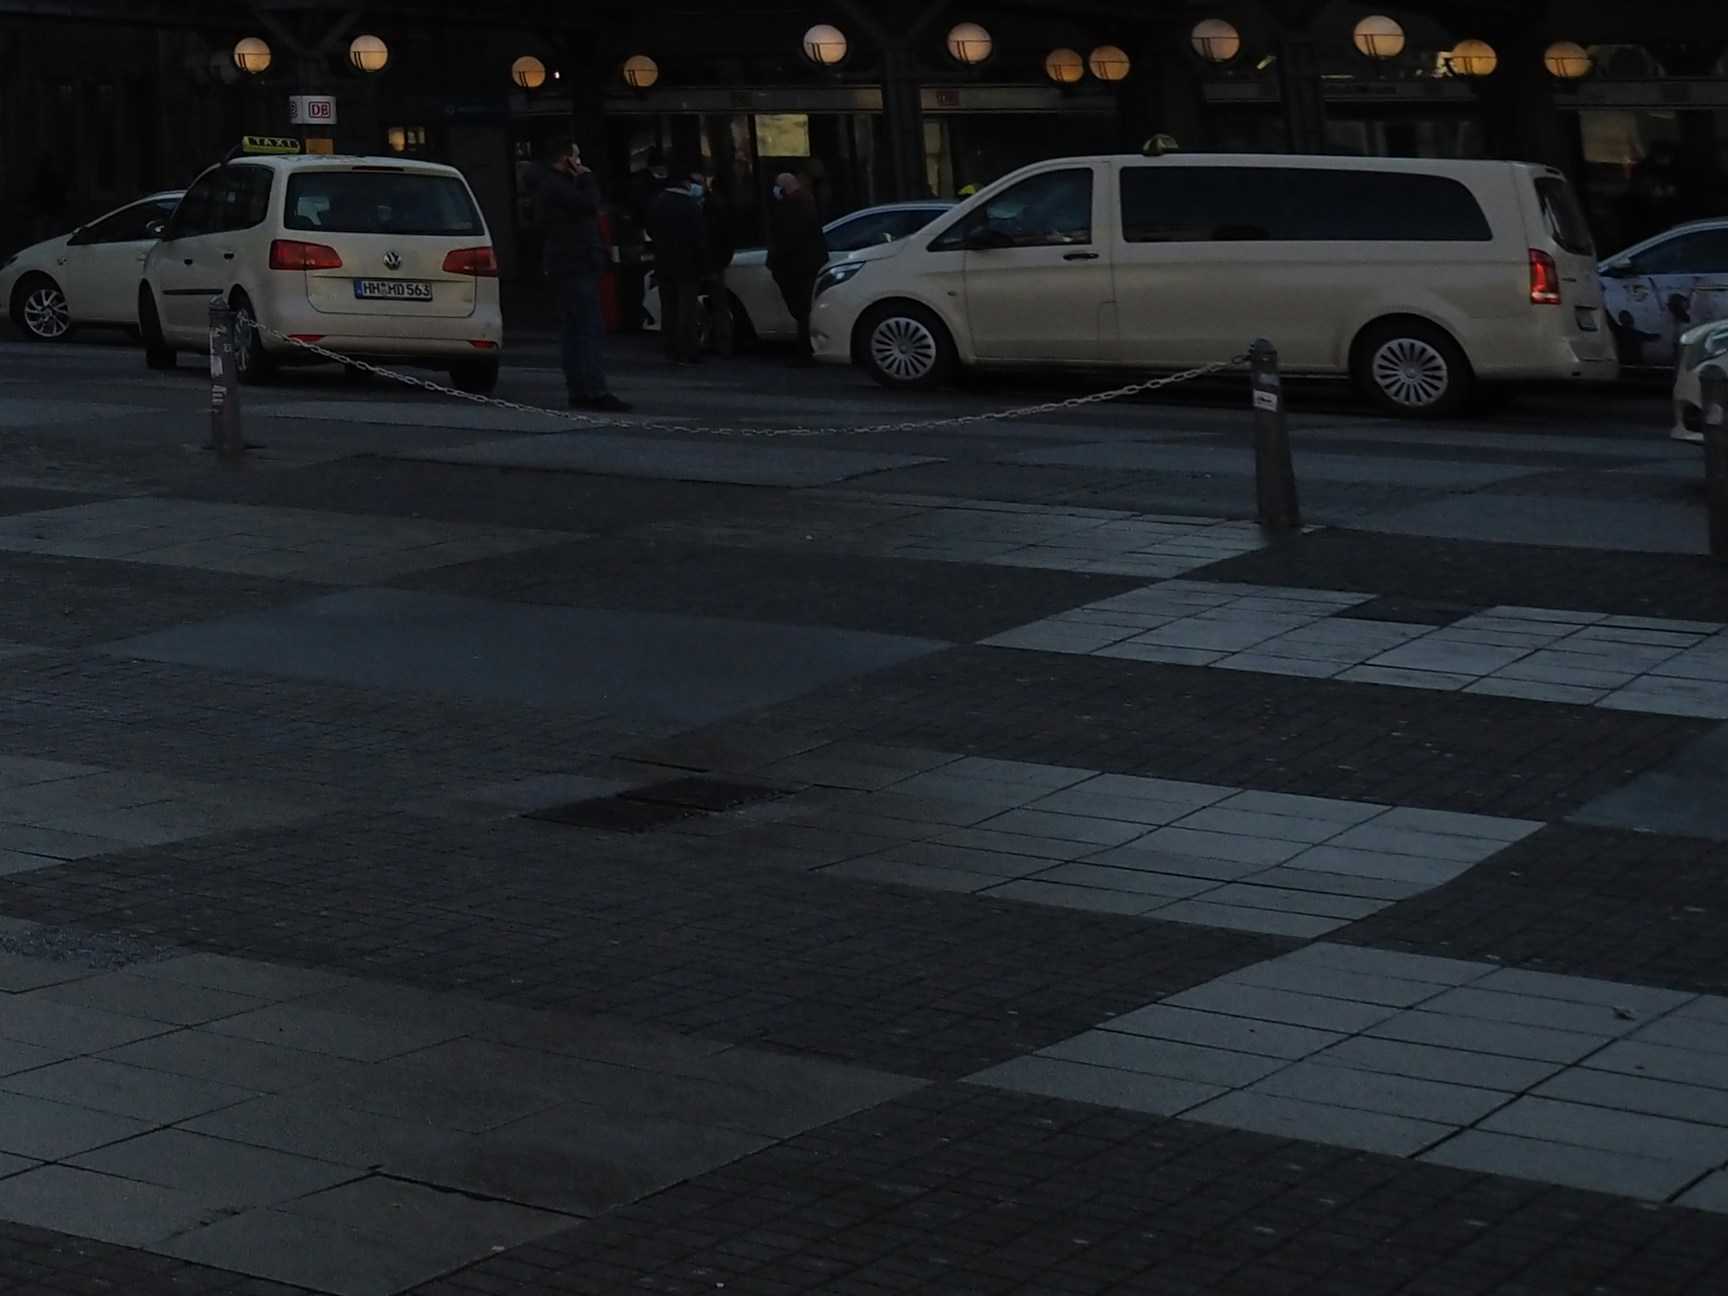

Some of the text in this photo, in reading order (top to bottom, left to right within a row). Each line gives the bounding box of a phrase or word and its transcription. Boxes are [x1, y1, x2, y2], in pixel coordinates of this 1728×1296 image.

[311, 103, 329, 116] DB
[363, 282, 380, 295] HH
[406, 283, 430, 297] 563
